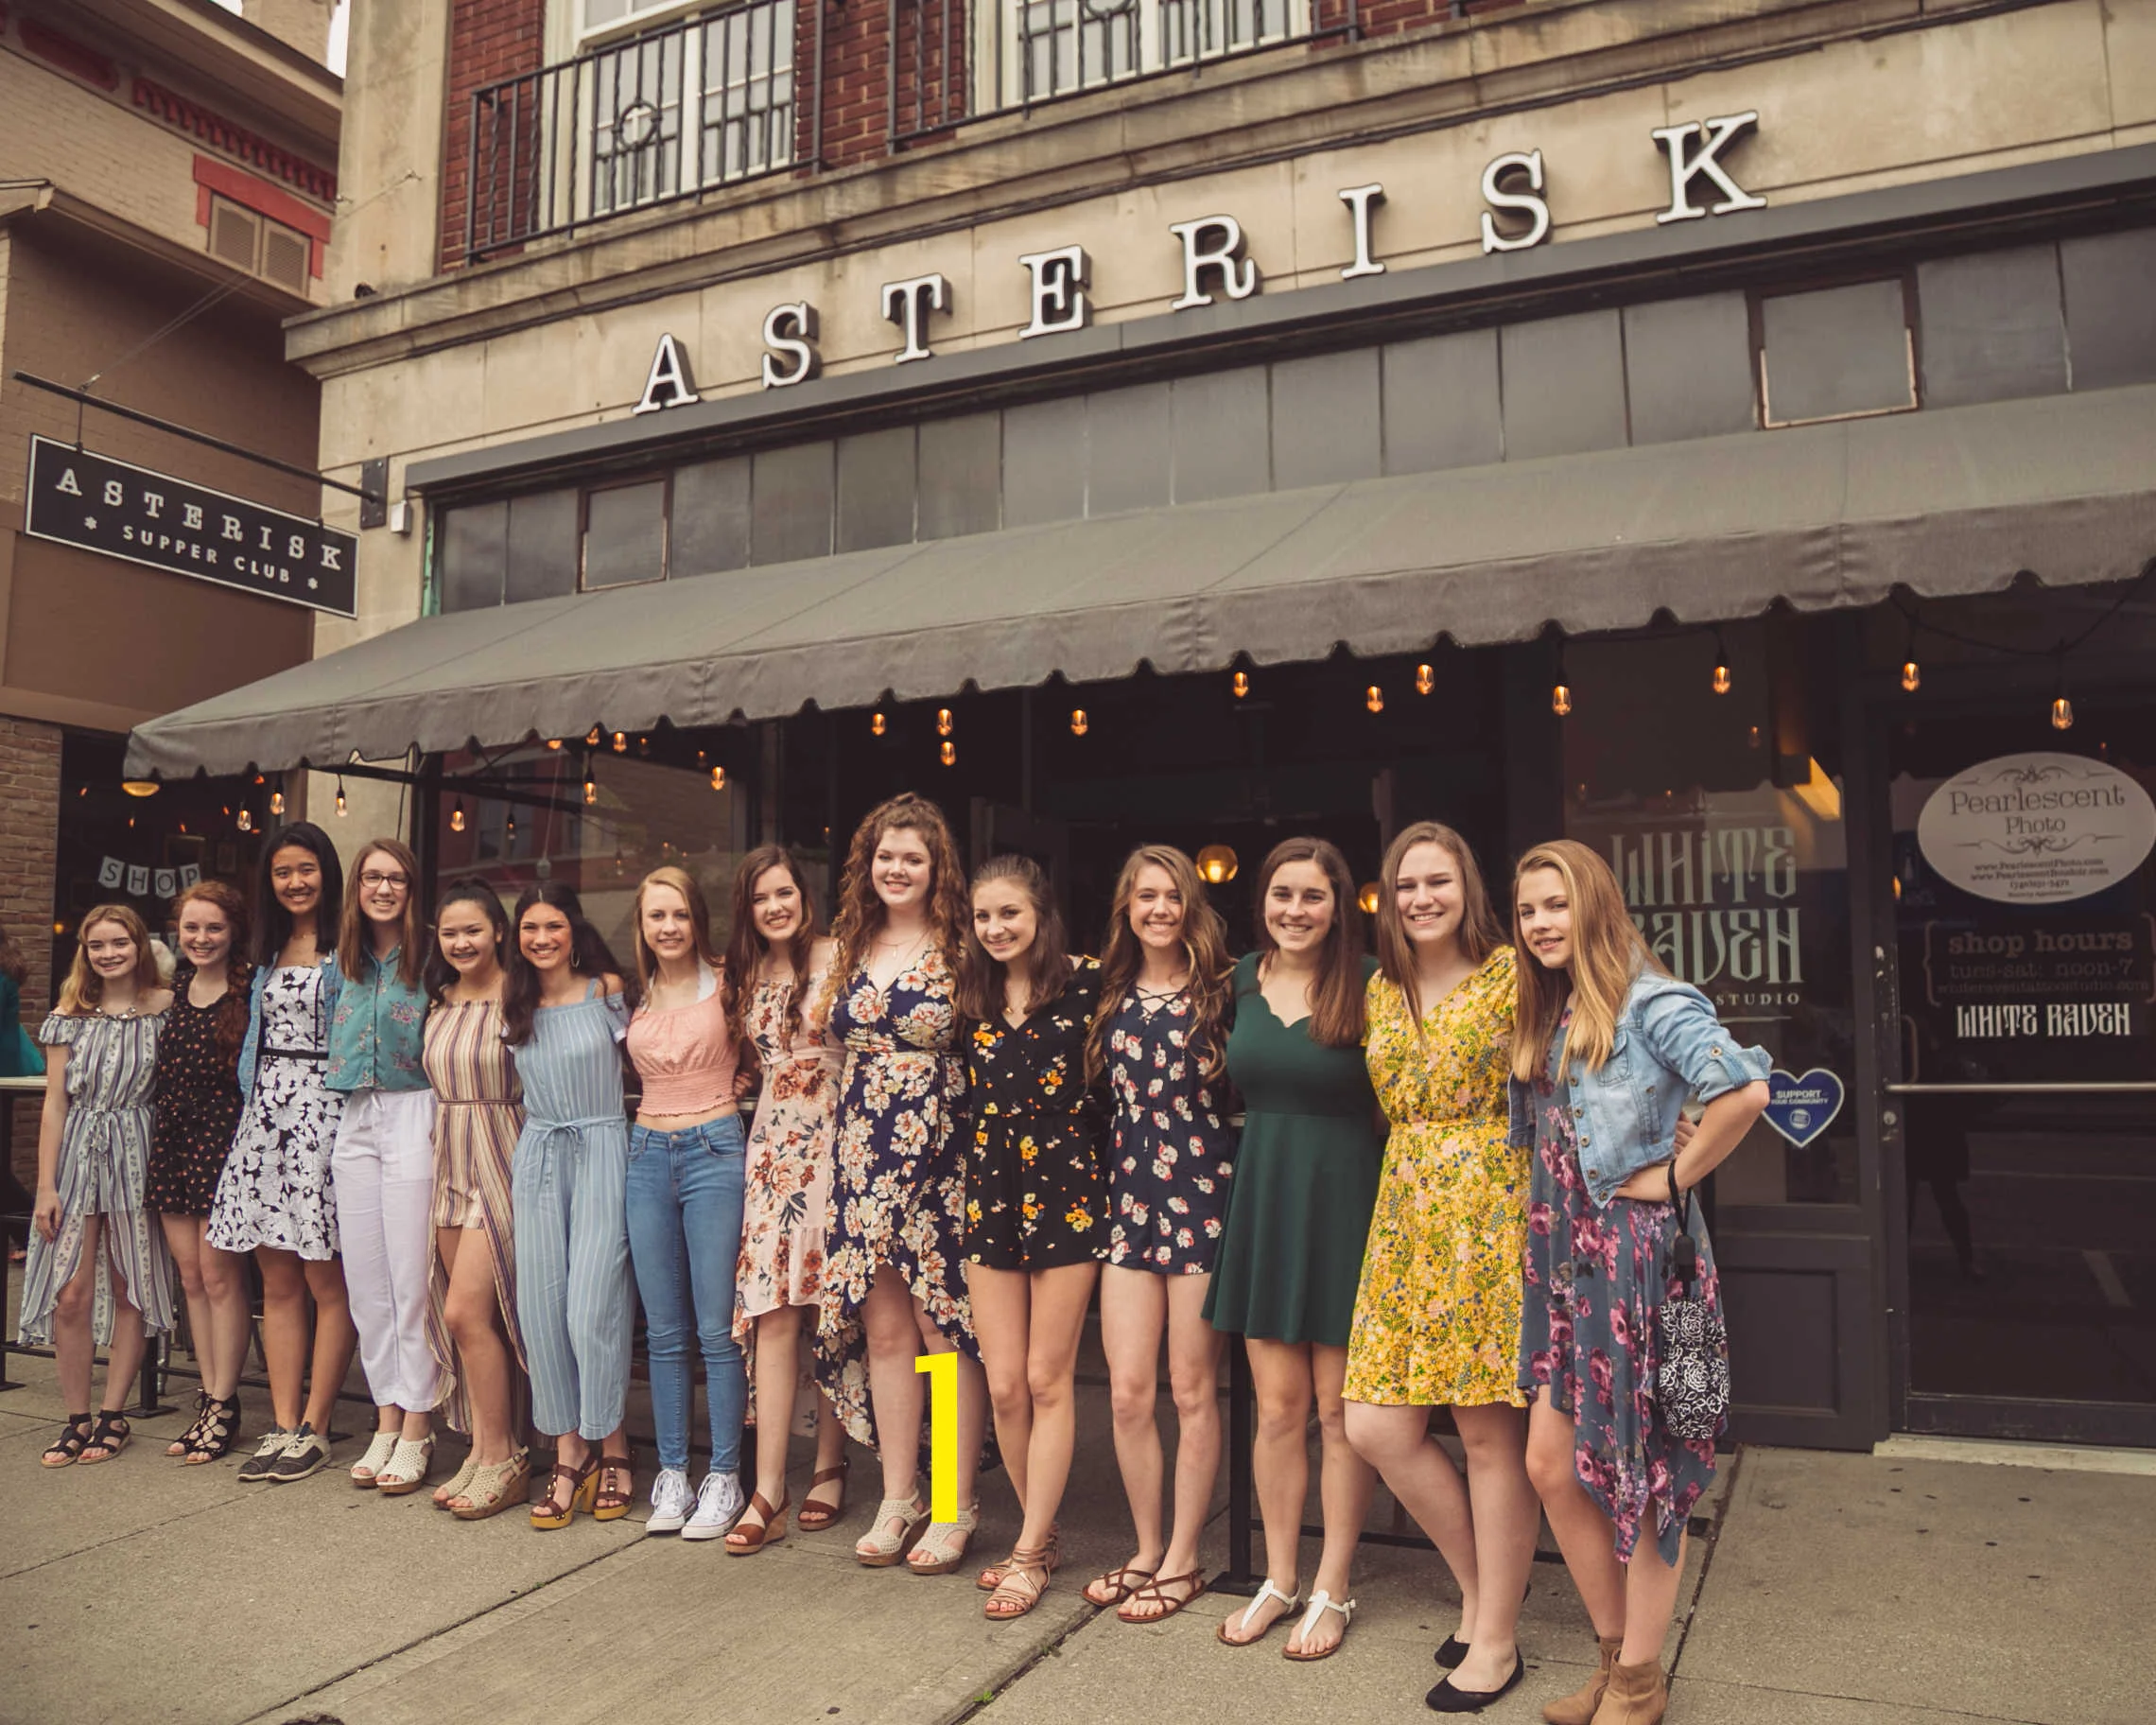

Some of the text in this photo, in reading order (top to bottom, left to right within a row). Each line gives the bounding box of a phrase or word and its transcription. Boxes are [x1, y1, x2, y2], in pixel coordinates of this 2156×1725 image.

[632, 110, 1766, 414] ASTERISK
[56, 468, 341, 571] ASTERISK
[123, 525, 289, 584] SUPPER CLUB
[1949, 784, 2126, 815] Pearlescent
[2006, 815, 2066, 835] Photo
[104, 862, 198, 892] SHOP
[1611, 827, 1797, 906] WHITE
[1628, 907, 1804, 985] AVEN
[1948, 929, 2133, 958] shop hours
[2055, 957, 2134, 977] noon-7
[1716, 992, 1800, 1006] STUDIO
[1956, 1002, 2131, 1037] WHITE RAVEN
[1776, 1089, 1822, 1099] SUPPORT
